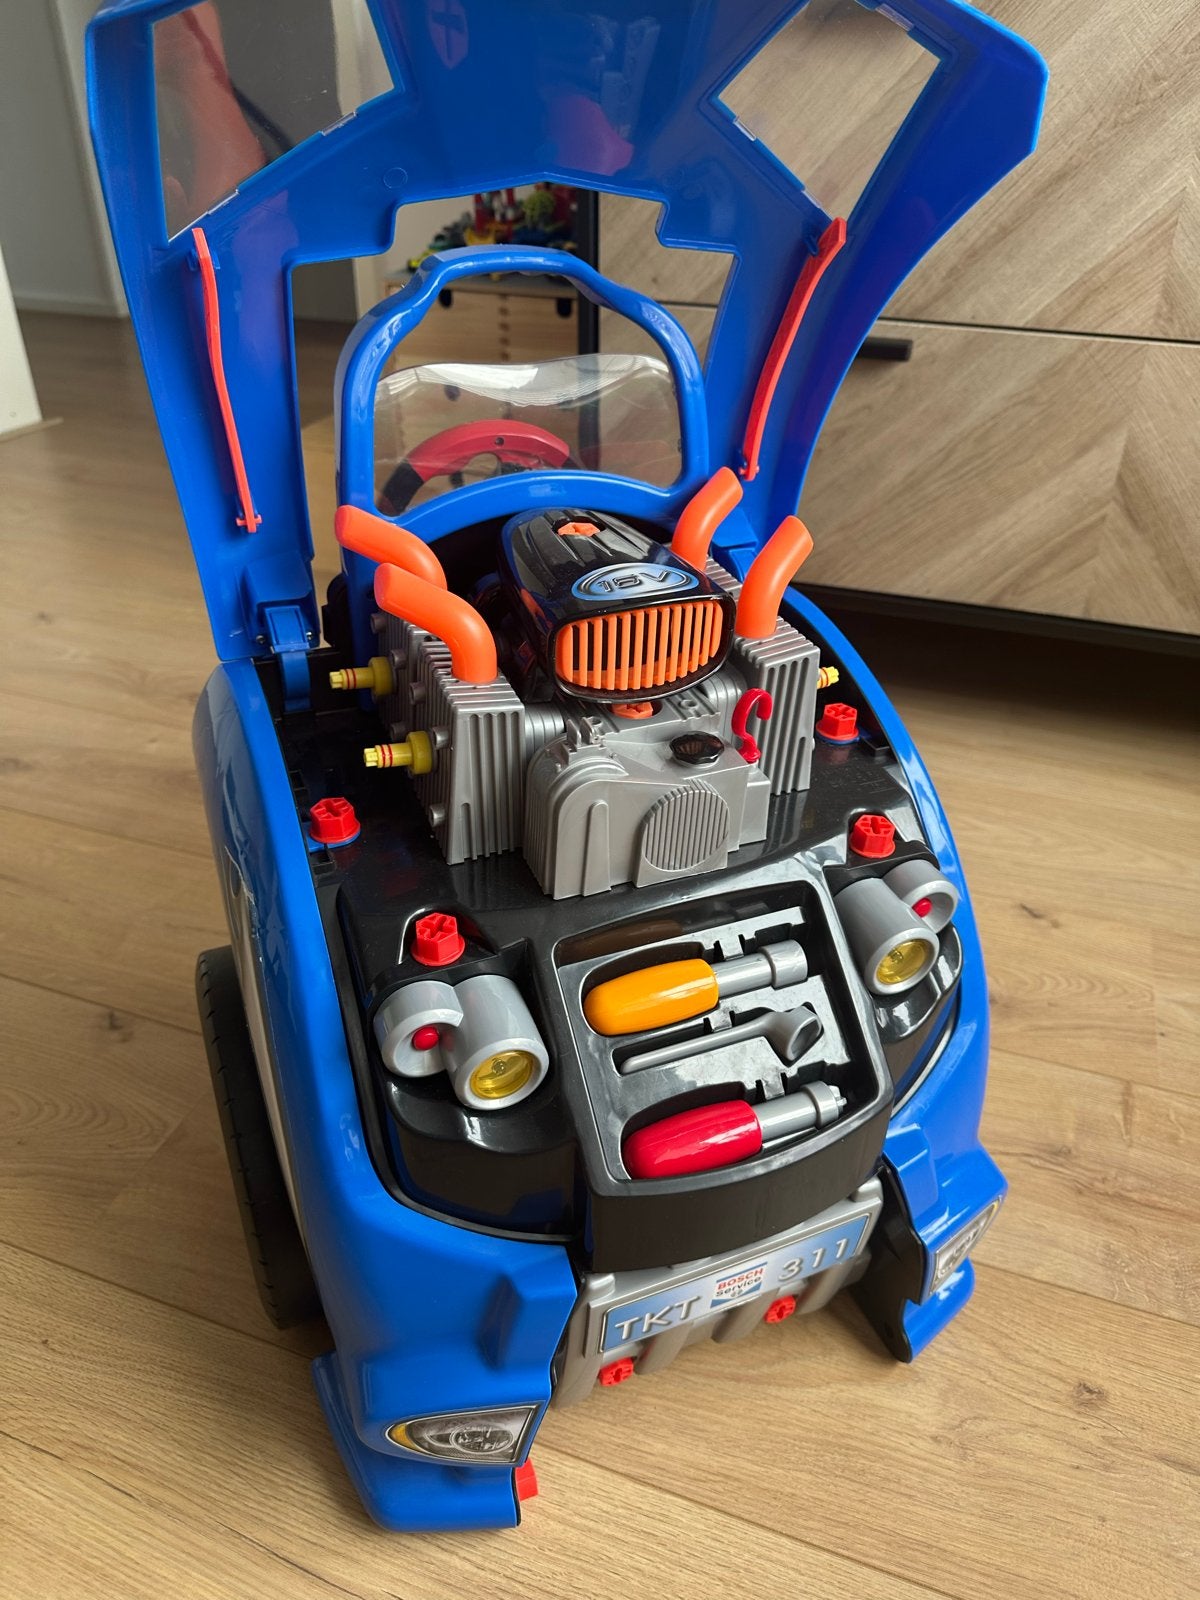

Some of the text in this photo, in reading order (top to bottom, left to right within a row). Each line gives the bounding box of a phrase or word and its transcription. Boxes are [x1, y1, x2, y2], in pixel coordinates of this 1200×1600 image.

[615, 1238, 849, 1340] TKT 311
[715, 1276, 762, 1297] Service
[717, 1267, 764, 1291] BOSCH
